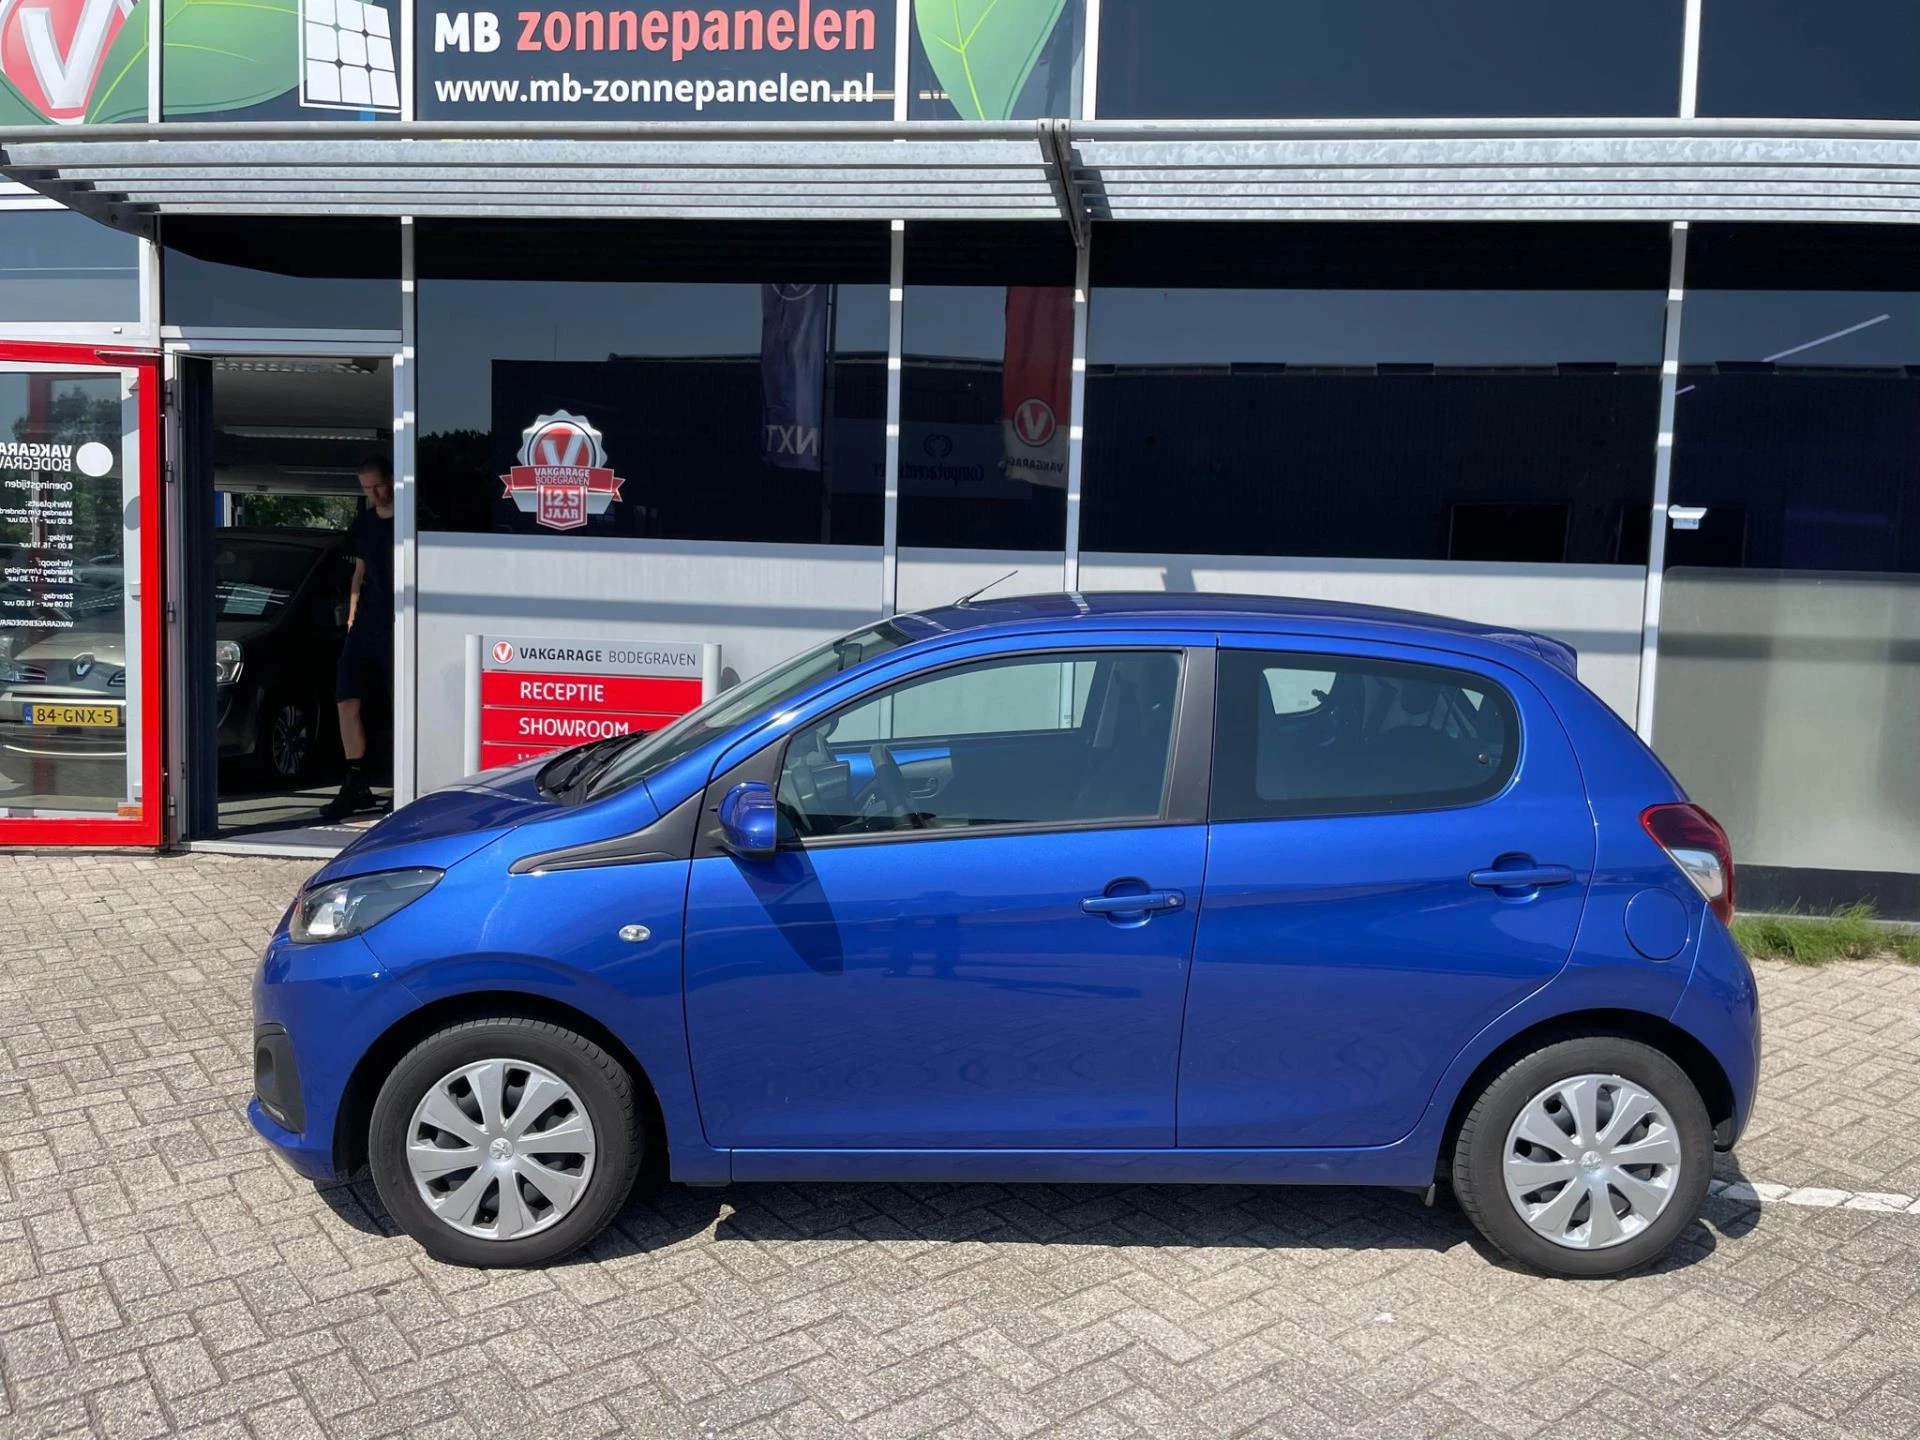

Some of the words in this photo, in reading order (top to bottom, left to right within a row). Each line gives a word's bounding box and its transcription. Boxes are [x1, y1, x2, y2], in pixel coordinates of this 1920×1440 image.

[434, 12, 501, 52] MB
[517, 0, 876, 61] zonnepanelen
[434, 72, 874, 111] www.mb-zonnepanelen.nl
[534, 467, 591, 477] VAKGARAGE
[535, 476, 590, 486] BODEGRAVEN
[545, 490, 580, 507] 12.5
[545, 508, 579, 519] JAAR
[519, 647, 602, 662] VAKGARAGE
[608, 650, 696, 666] BODEGRAVEN
[520, 681, 605, 703] RECEPTIE
[37, 708, 113, 724] 84-GNX-5
[519, 717, 629, 739] SHOWROOM
